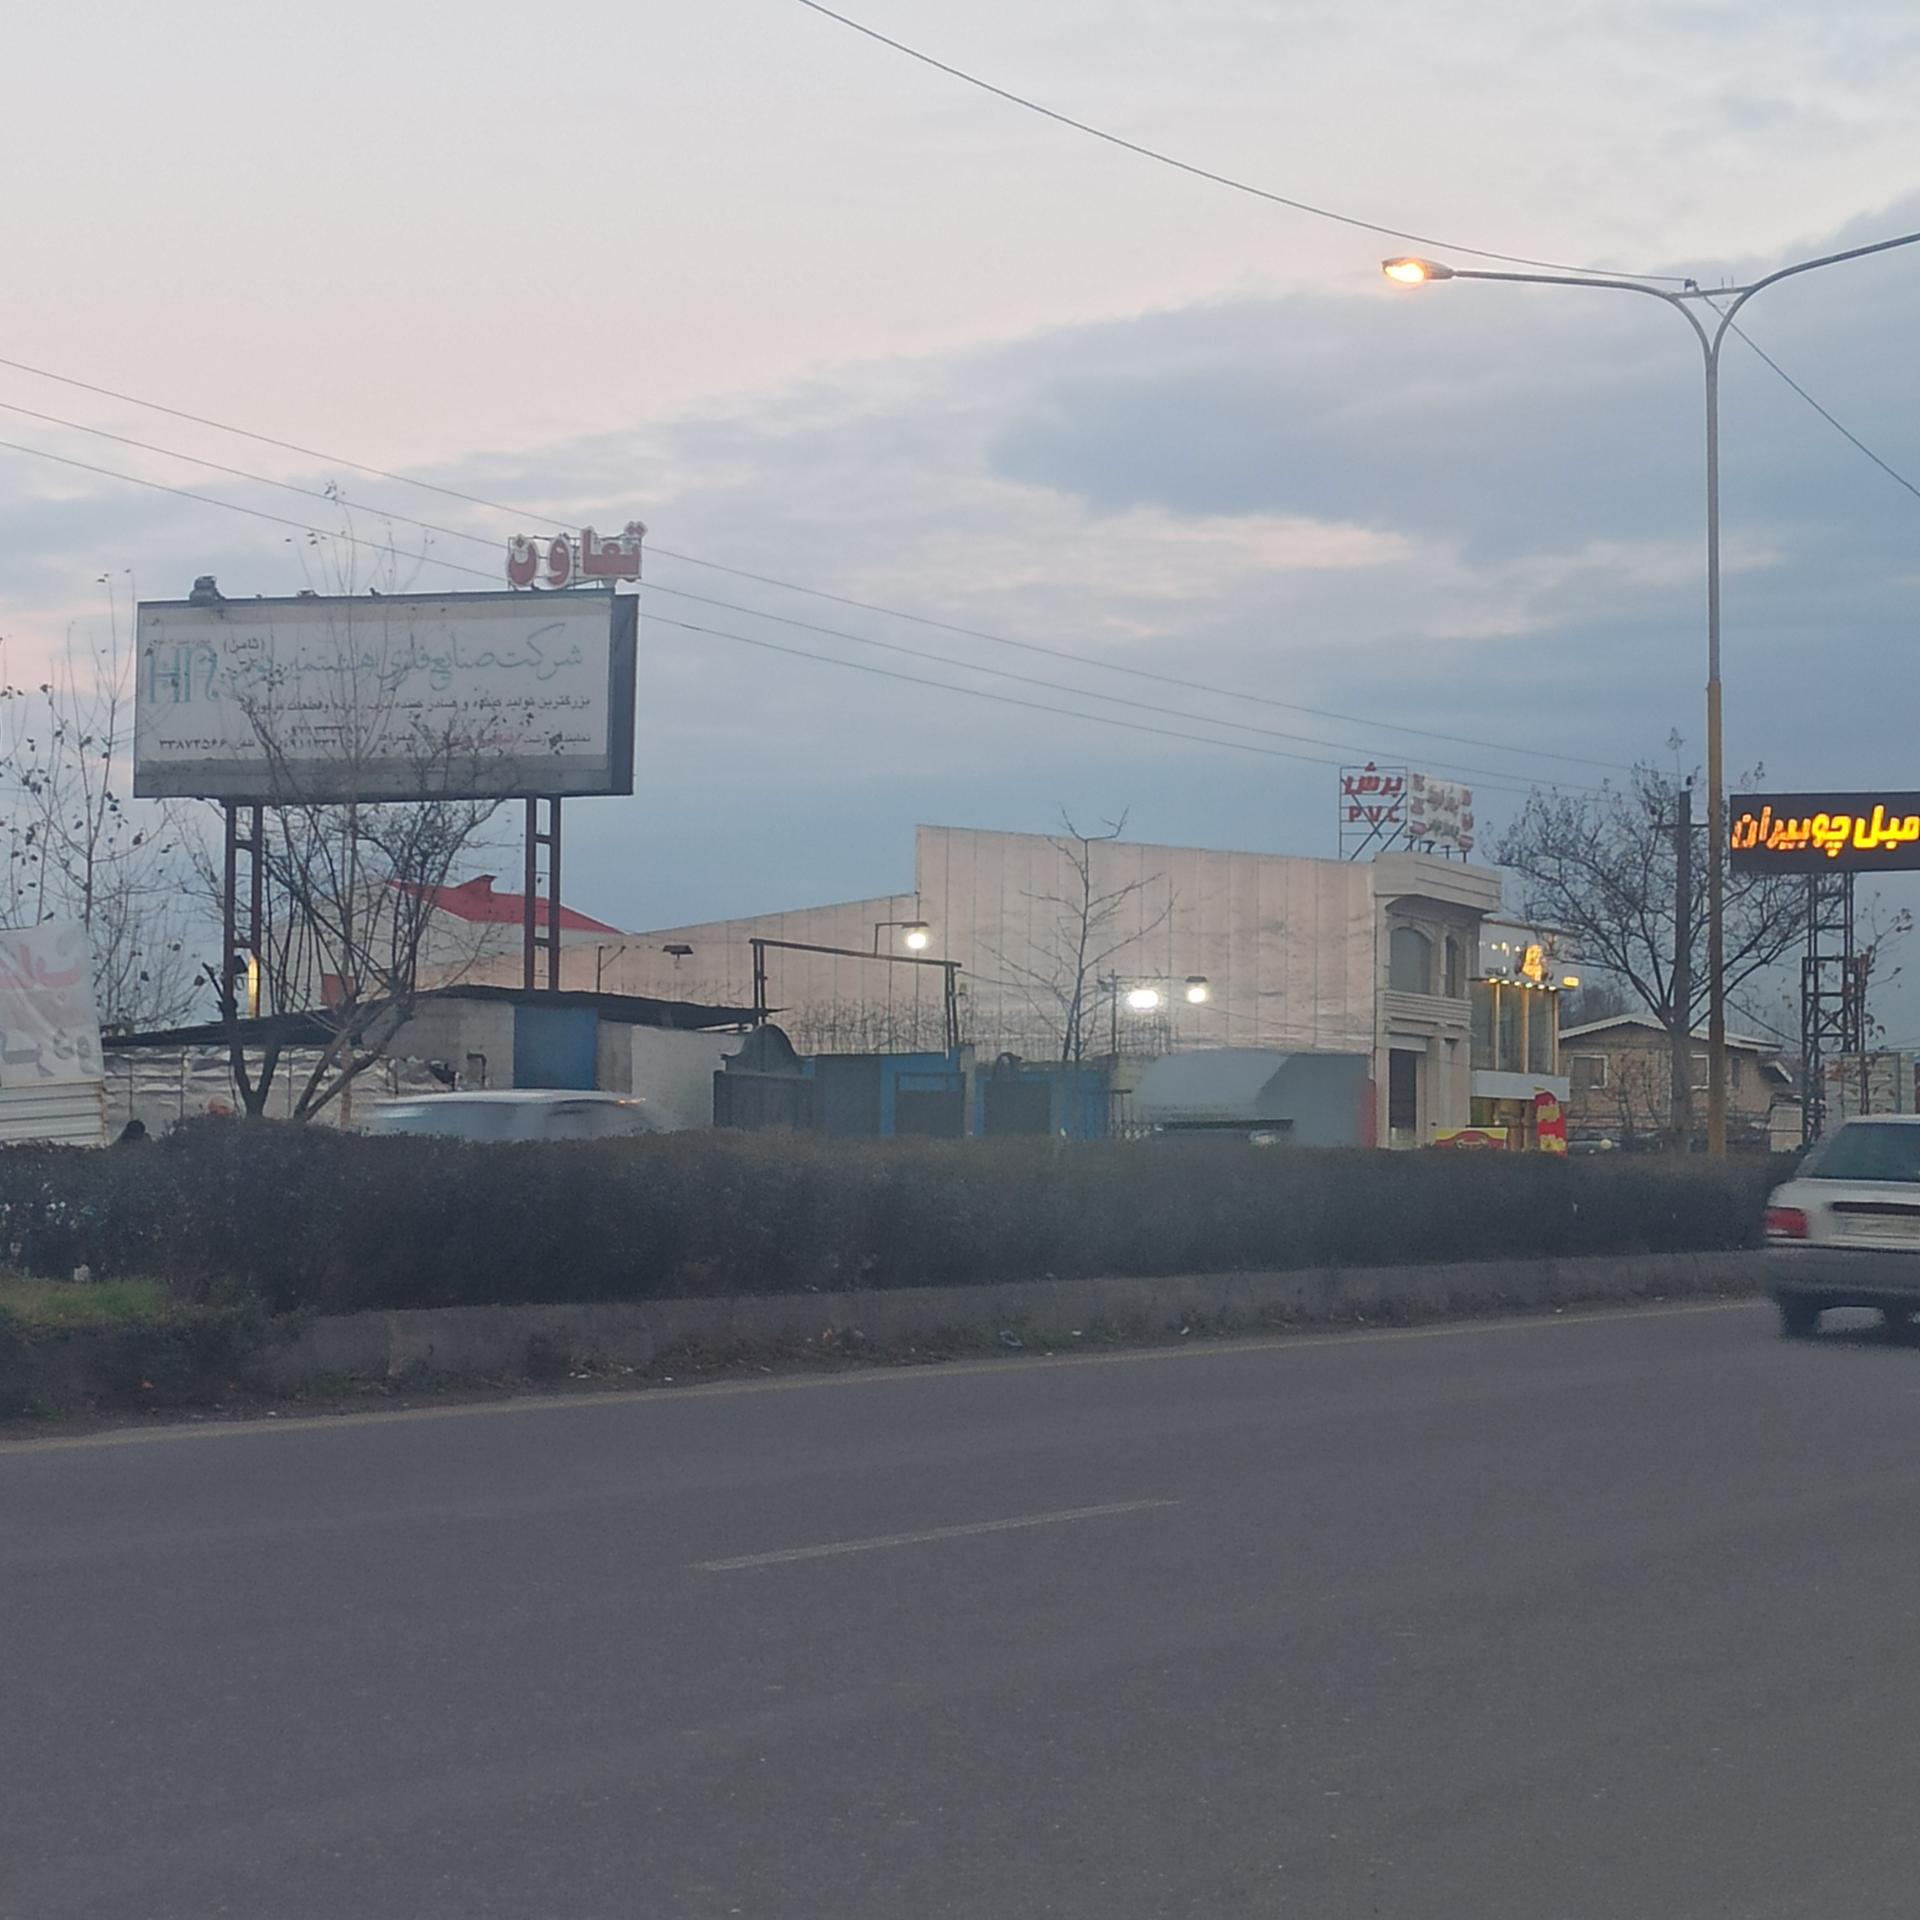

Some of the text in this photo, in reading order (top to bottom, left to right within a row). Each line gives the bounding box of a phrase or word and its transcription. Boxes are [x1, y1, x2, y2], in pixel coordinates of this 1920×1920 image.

[507, 521, 646, 588] تعاون
[429, 630, 496, 691] صنایع
[497, 622, 583, 681] شرکت
[1343, 762, 1403, 797] برش
[1348, 806, 1400, 822] PVC
[1852, 804, 1920, 850] مبل
